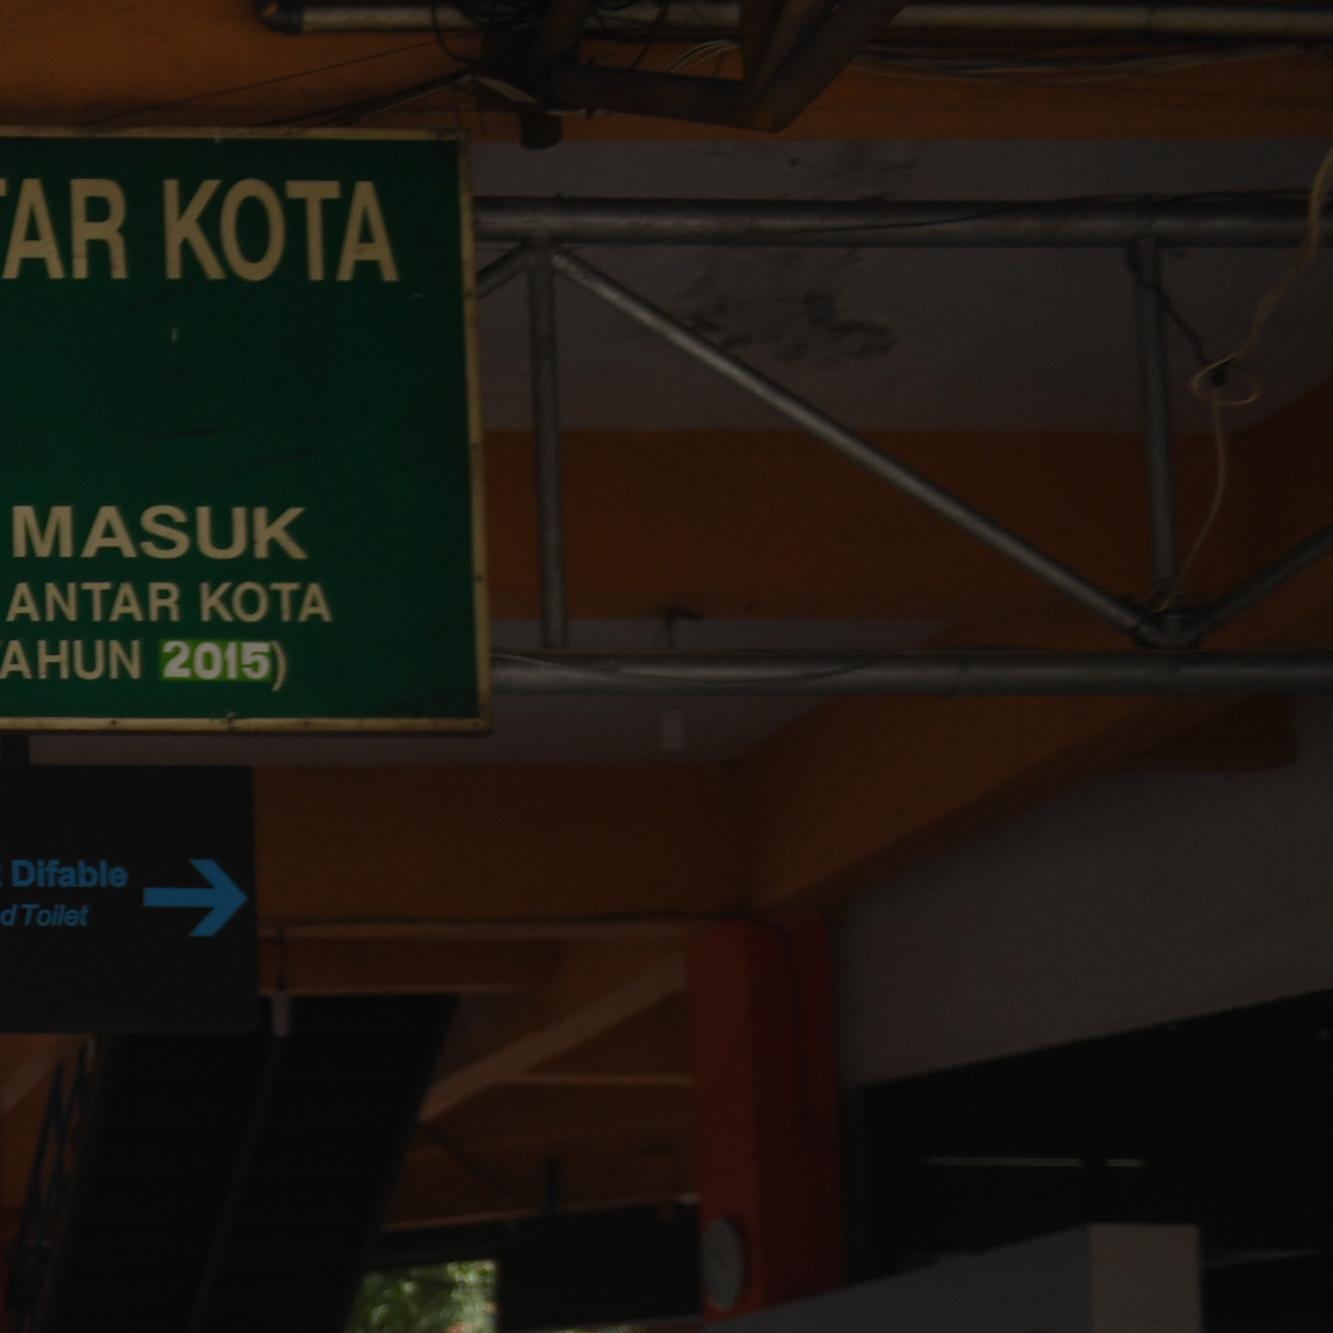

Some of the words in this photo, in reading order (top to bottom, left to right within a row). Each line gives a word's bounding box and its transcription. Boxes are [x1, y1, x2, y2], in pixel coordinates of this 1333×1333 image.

[164, 179, 400, 282] KOTA
[11, 505, 309, 559] MASUK
[6, 582, 180, 623] ANTAR
[199, 582, 333, 623] KOTA
[161, 640, 288, 691] 2015)
[10, 859, 129, 889] Difable
[20, 903, 90, 926] Toilet
